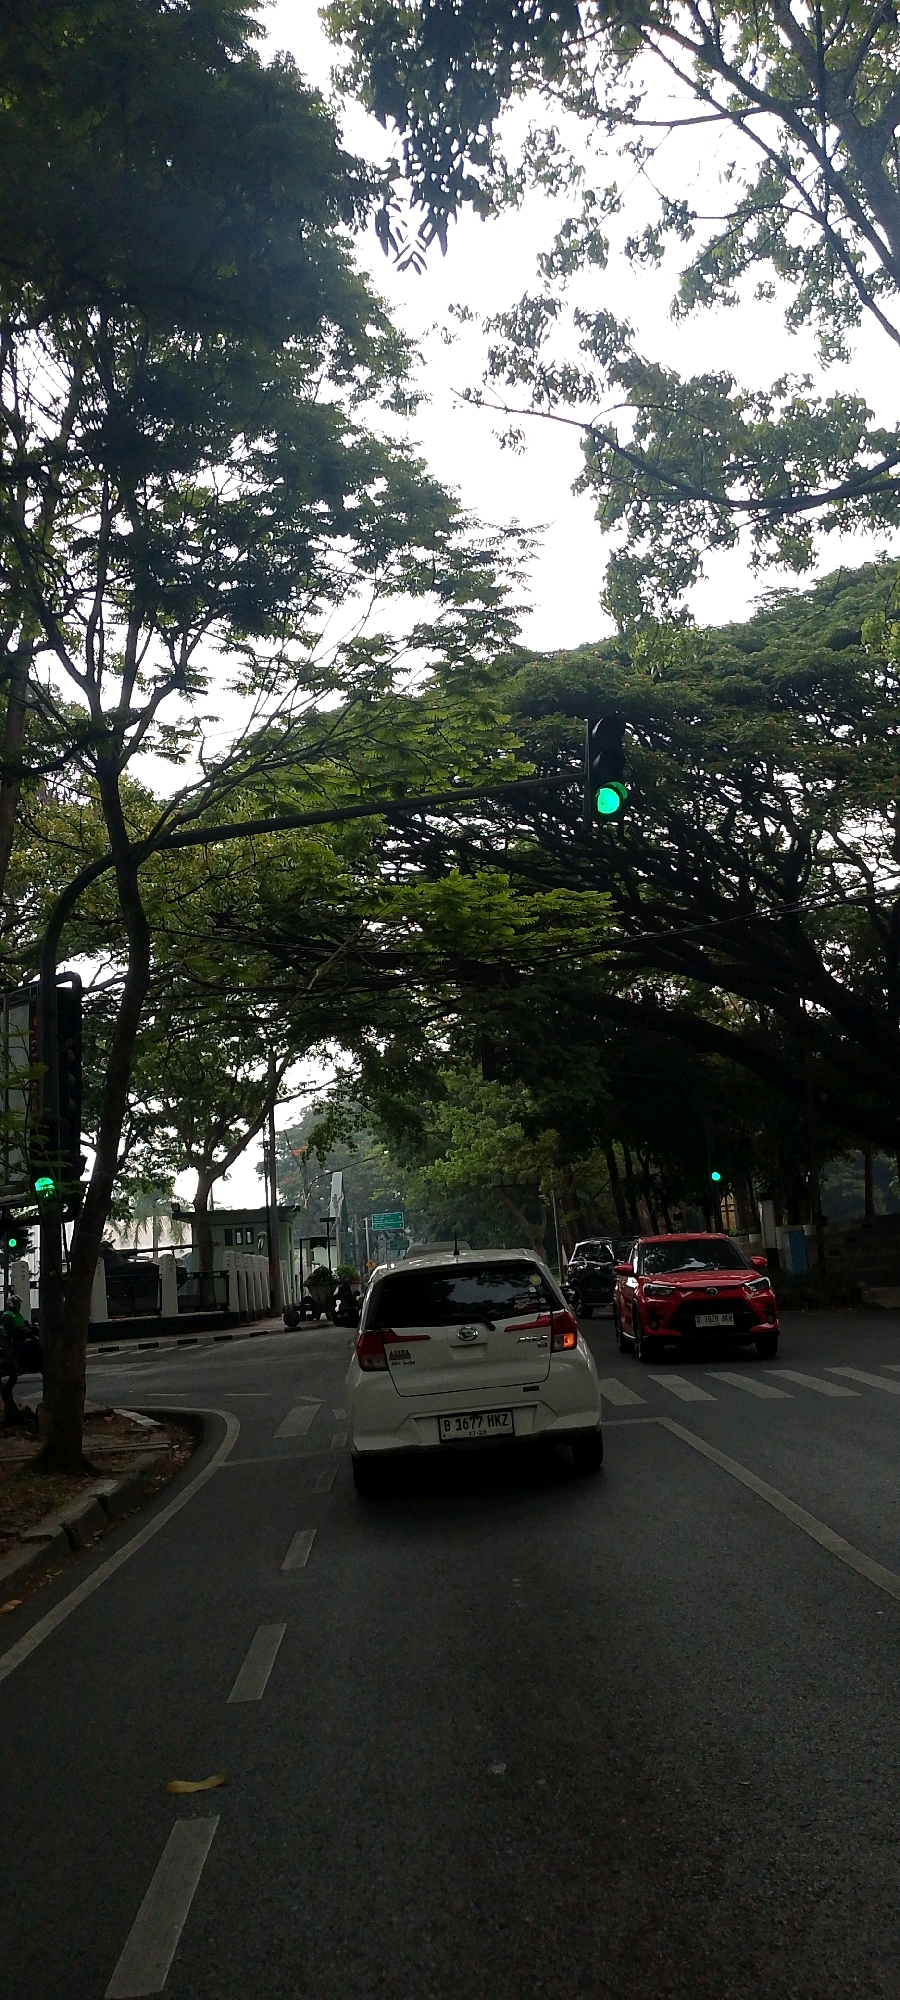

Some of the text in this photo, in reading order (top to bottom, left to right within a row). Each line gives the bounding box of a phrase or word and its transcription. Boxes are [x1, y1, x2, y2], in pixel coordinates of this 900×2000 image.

[444, 1413, 510, 1432] B 1677 HKZ
